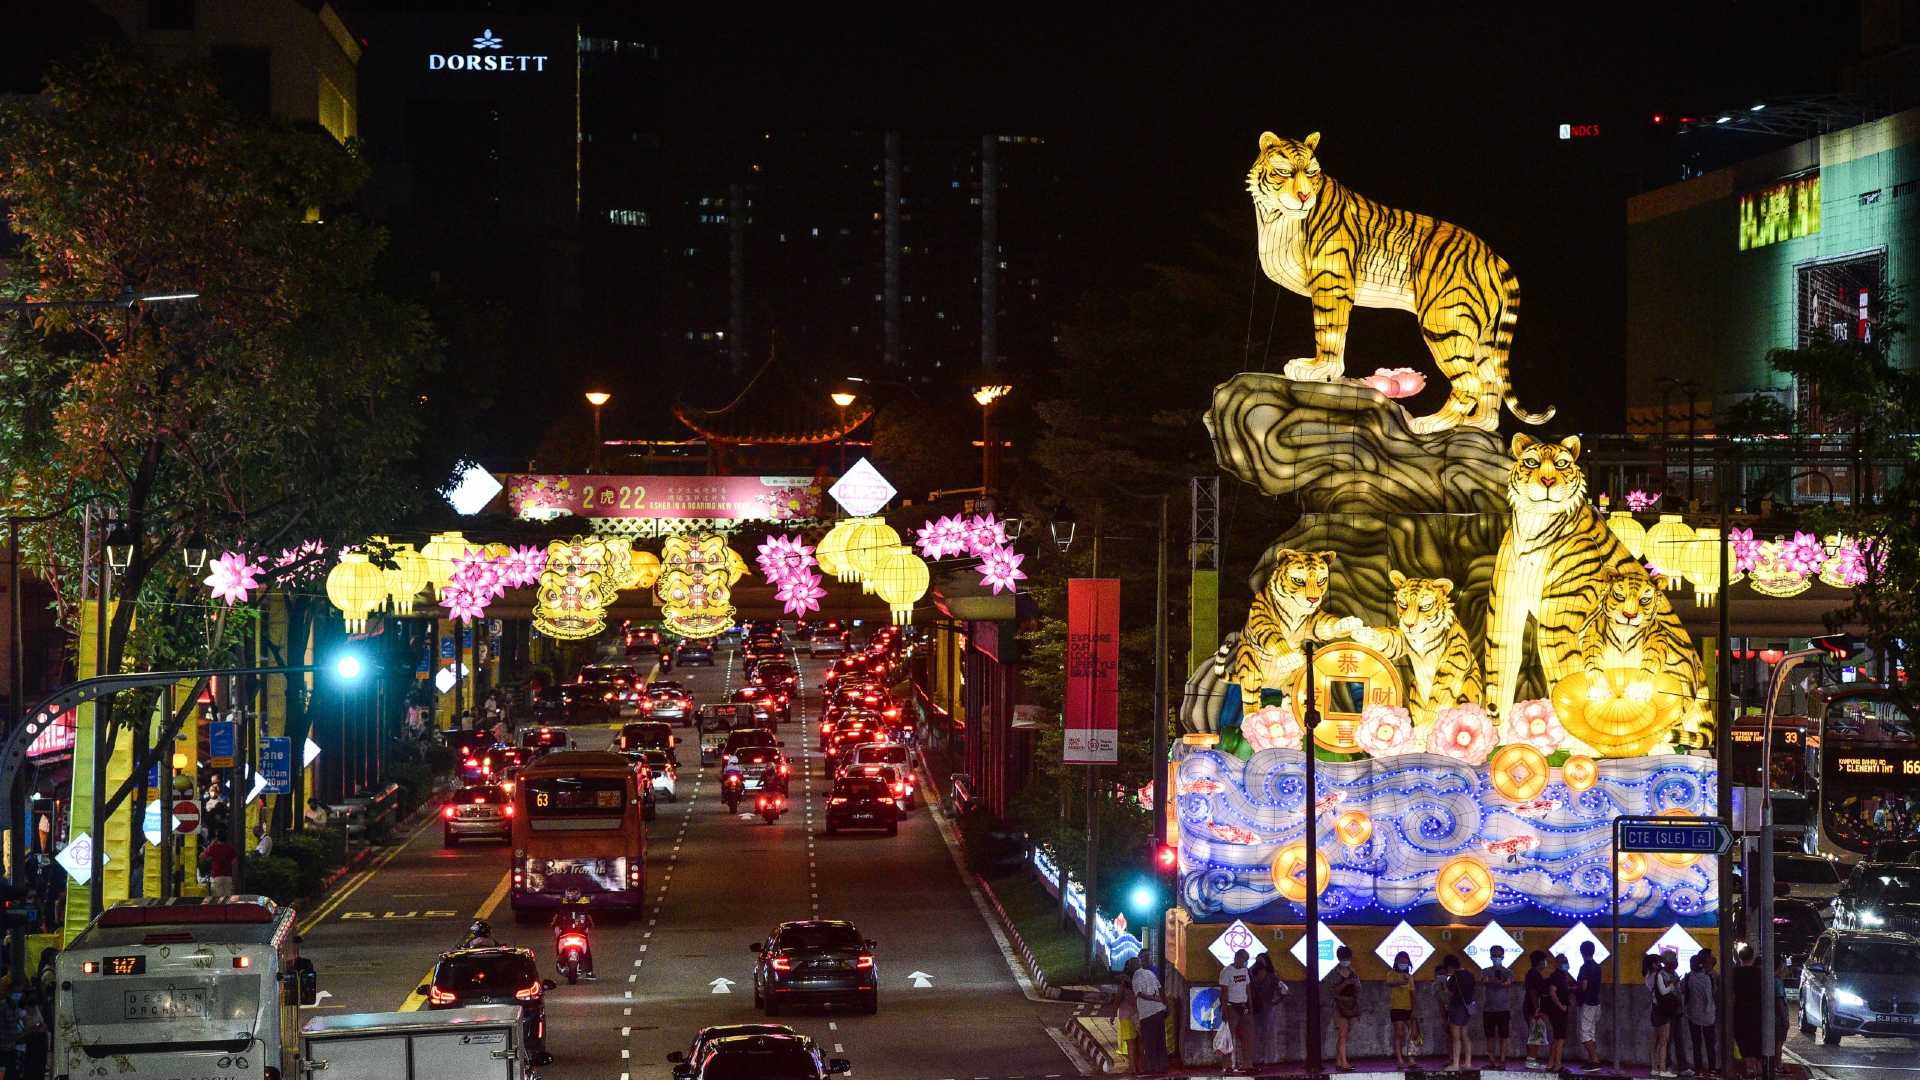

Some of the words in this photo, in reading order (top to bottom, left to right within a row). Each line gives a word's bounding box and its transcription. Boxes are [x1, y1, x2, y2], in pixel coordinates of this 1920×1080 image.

[429, 54, 548, 71] DORSETT
[1337, 653, 1359, 673] 恭
[1373, 687, 1393, 705] 财
[1784, 732, 1798, 744] 33
[1881, 765, 1894, 773] INT
[1903, 760, 1920, 774] 166
[537, 793, 549, 807] 63
[1628, 831, 1649, 844] CTE
[1656, 831, 1685, 845] (SLE)
[340, 910, 458, 919] BUS
[112, 957, 136, 974] 147
